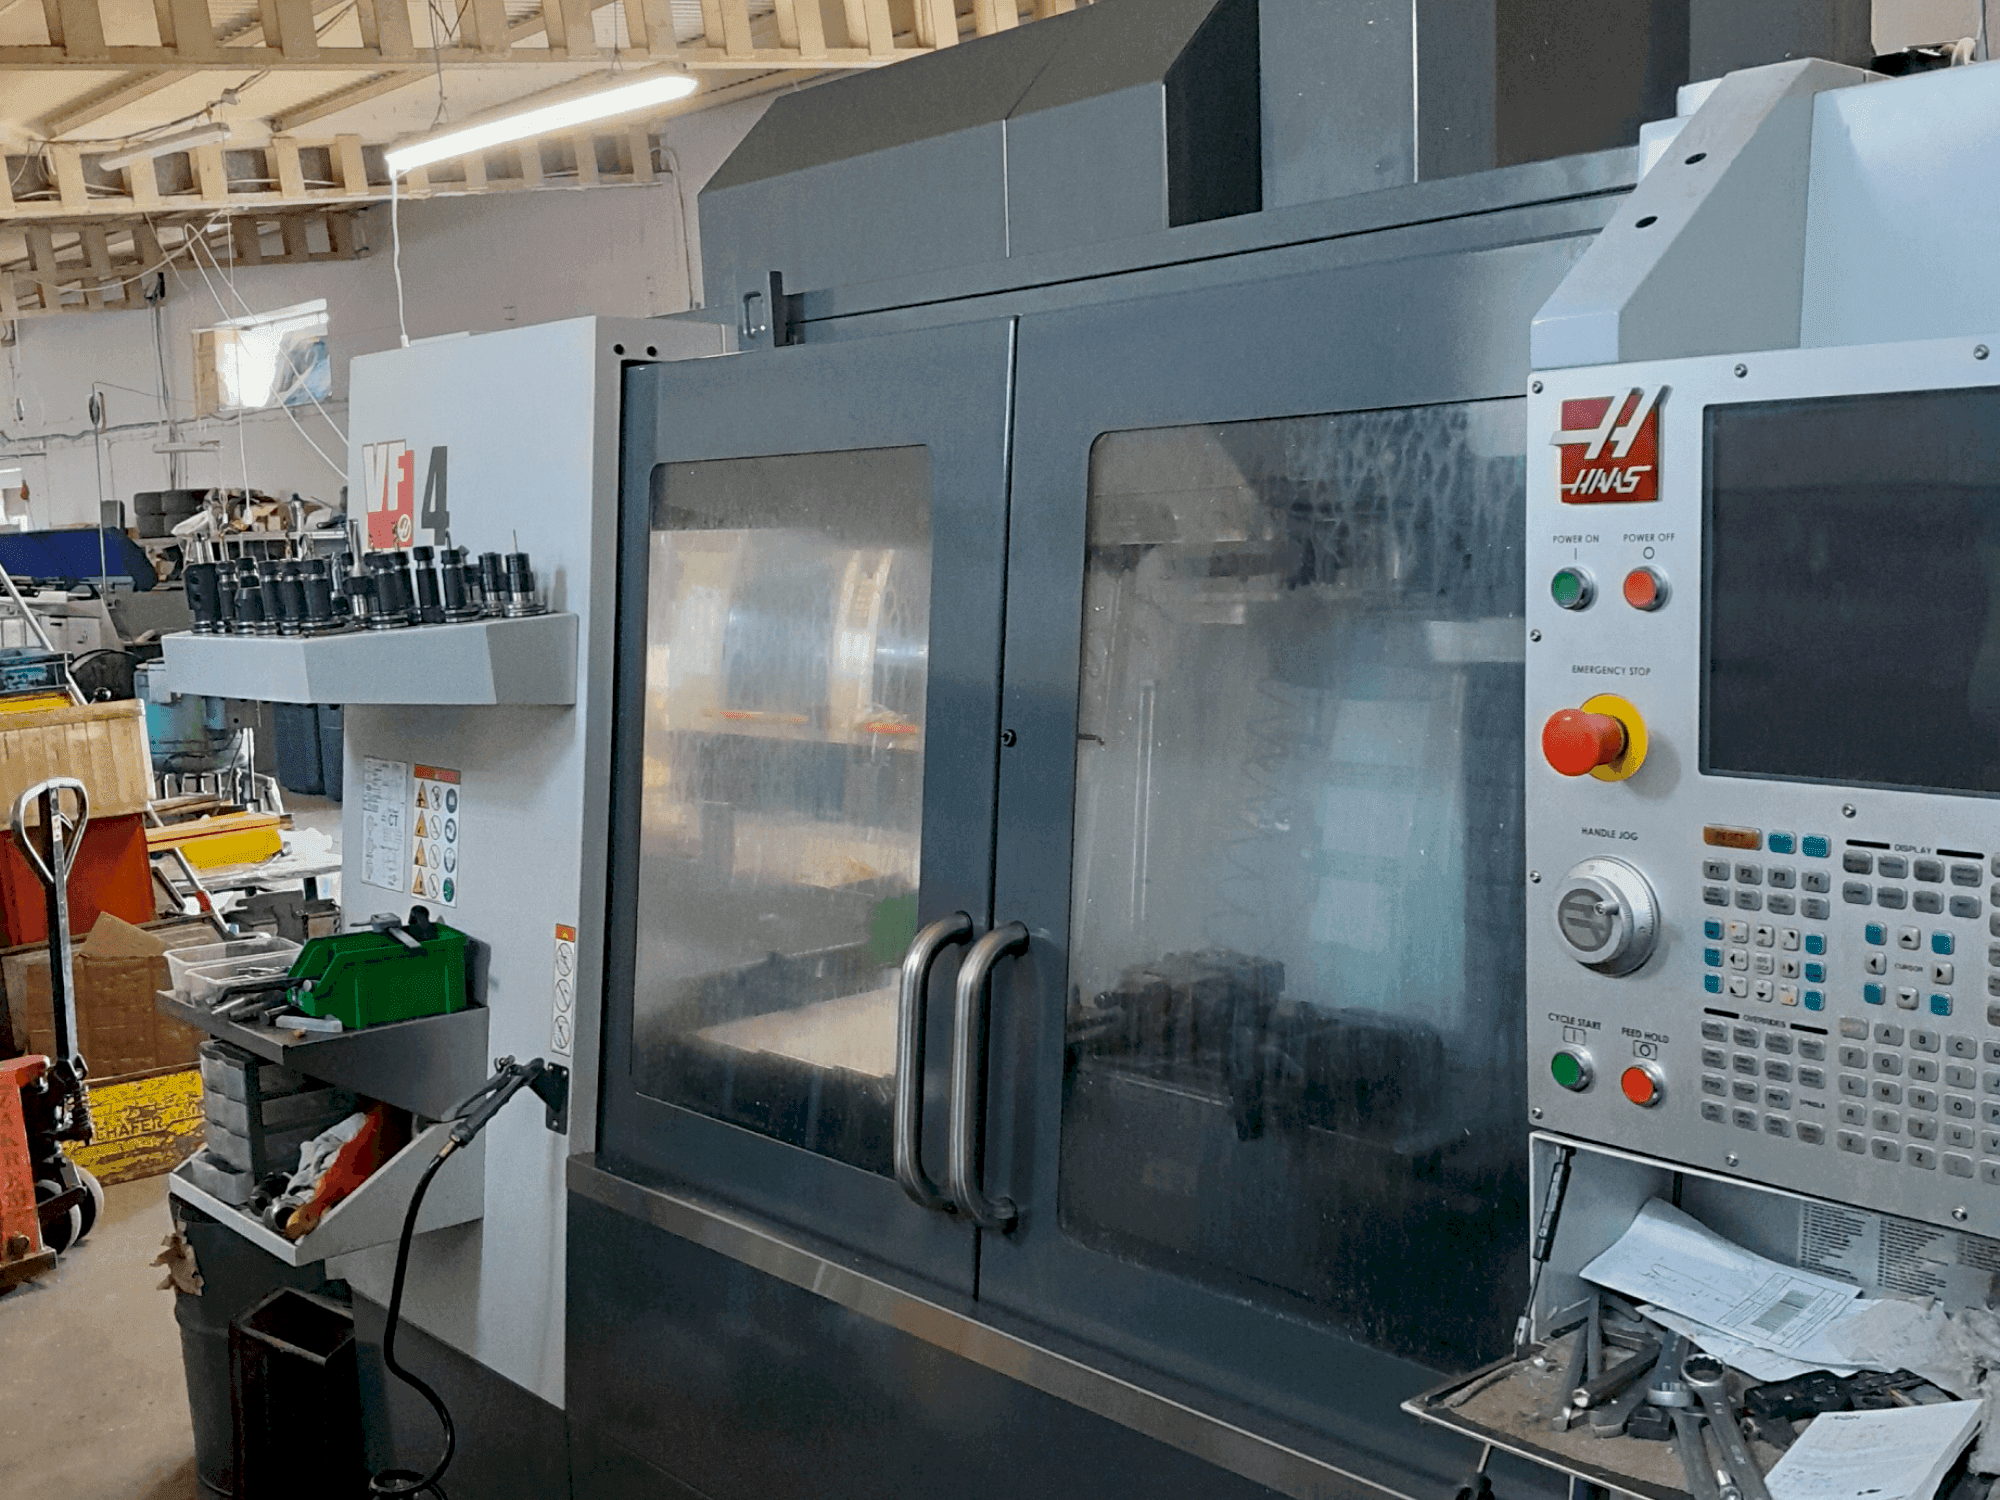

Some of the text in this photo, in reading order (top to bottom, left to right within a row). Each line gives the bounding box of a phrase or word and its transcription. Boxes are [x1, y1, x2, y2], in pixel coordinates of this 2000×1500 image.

[1560, 465, 1652, 495] HAAS
[362, 439, 450, 546] VF 4
[1552, 534, 1600, 544] POWER ON
[1623, 532, 1675, 543] POWER OFF
[1571, 664, 1651, 676] EMERGENCY STOP
[1581, 827, 1638, 841] HANDLE JOG
[1894, 843, 1932, 854] DISPLAY
[1709, 865, 1819, 885] F1 F2 F3 F4
[1548, 1012, 1601, 1030] CYCLE START
[1621, 1027, 1669, 1044] FEED HOLD
[1883, 1029, 1890, 1038] A
[1955, 1041, 1963, 1051] C
